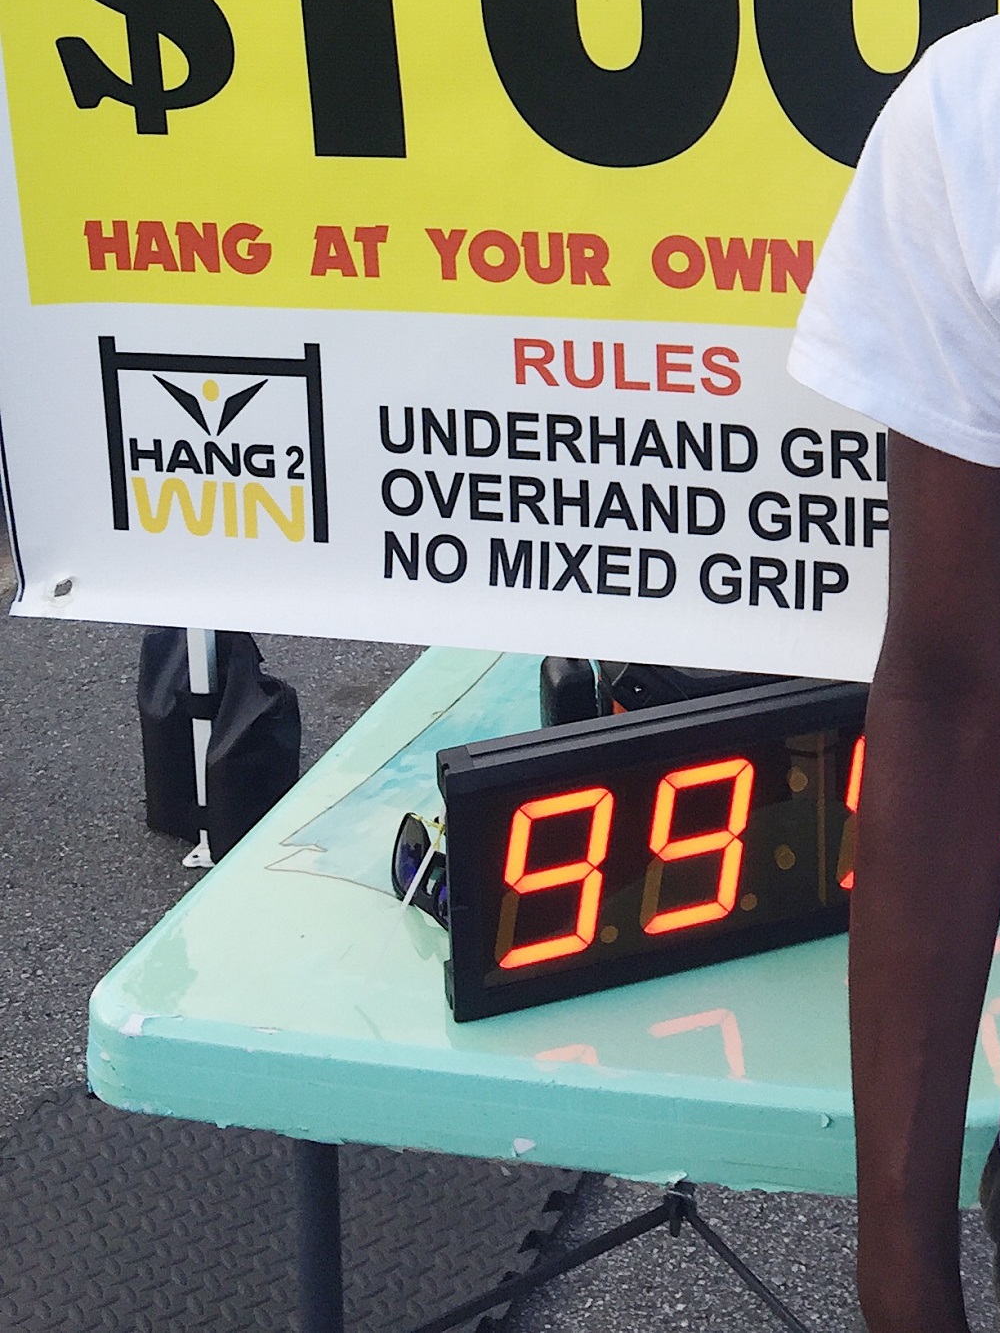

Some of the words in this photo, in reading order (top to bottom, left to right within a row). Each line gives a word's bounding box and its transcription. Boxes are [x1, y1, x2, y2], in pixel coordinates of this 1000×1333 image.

[84, 219, 272, 275] HANG
[310, 225, 389, 278] AT
[424, 228, 611, 286] YOUR
[650, 235, 814, 294] OWN
[513, 338, 742, 396] RULES
[129, 438, 278, 479] HANG
[286, 446, 306, 480] 2
[378, 406, 760, 473] UNDERHAND
[780, 427, 888, 483] GRI
[132, 476, 306, 543] WIN
[380, 469, 726, 535] OVERHAND
[748, 491, 890, 548] GRIP
[382, 531, 469, 584] NO
[489, 540, 677, 602] MIXED
[699, 553, 850, 612] GRIP
[497, 756, 755, 970] 99
